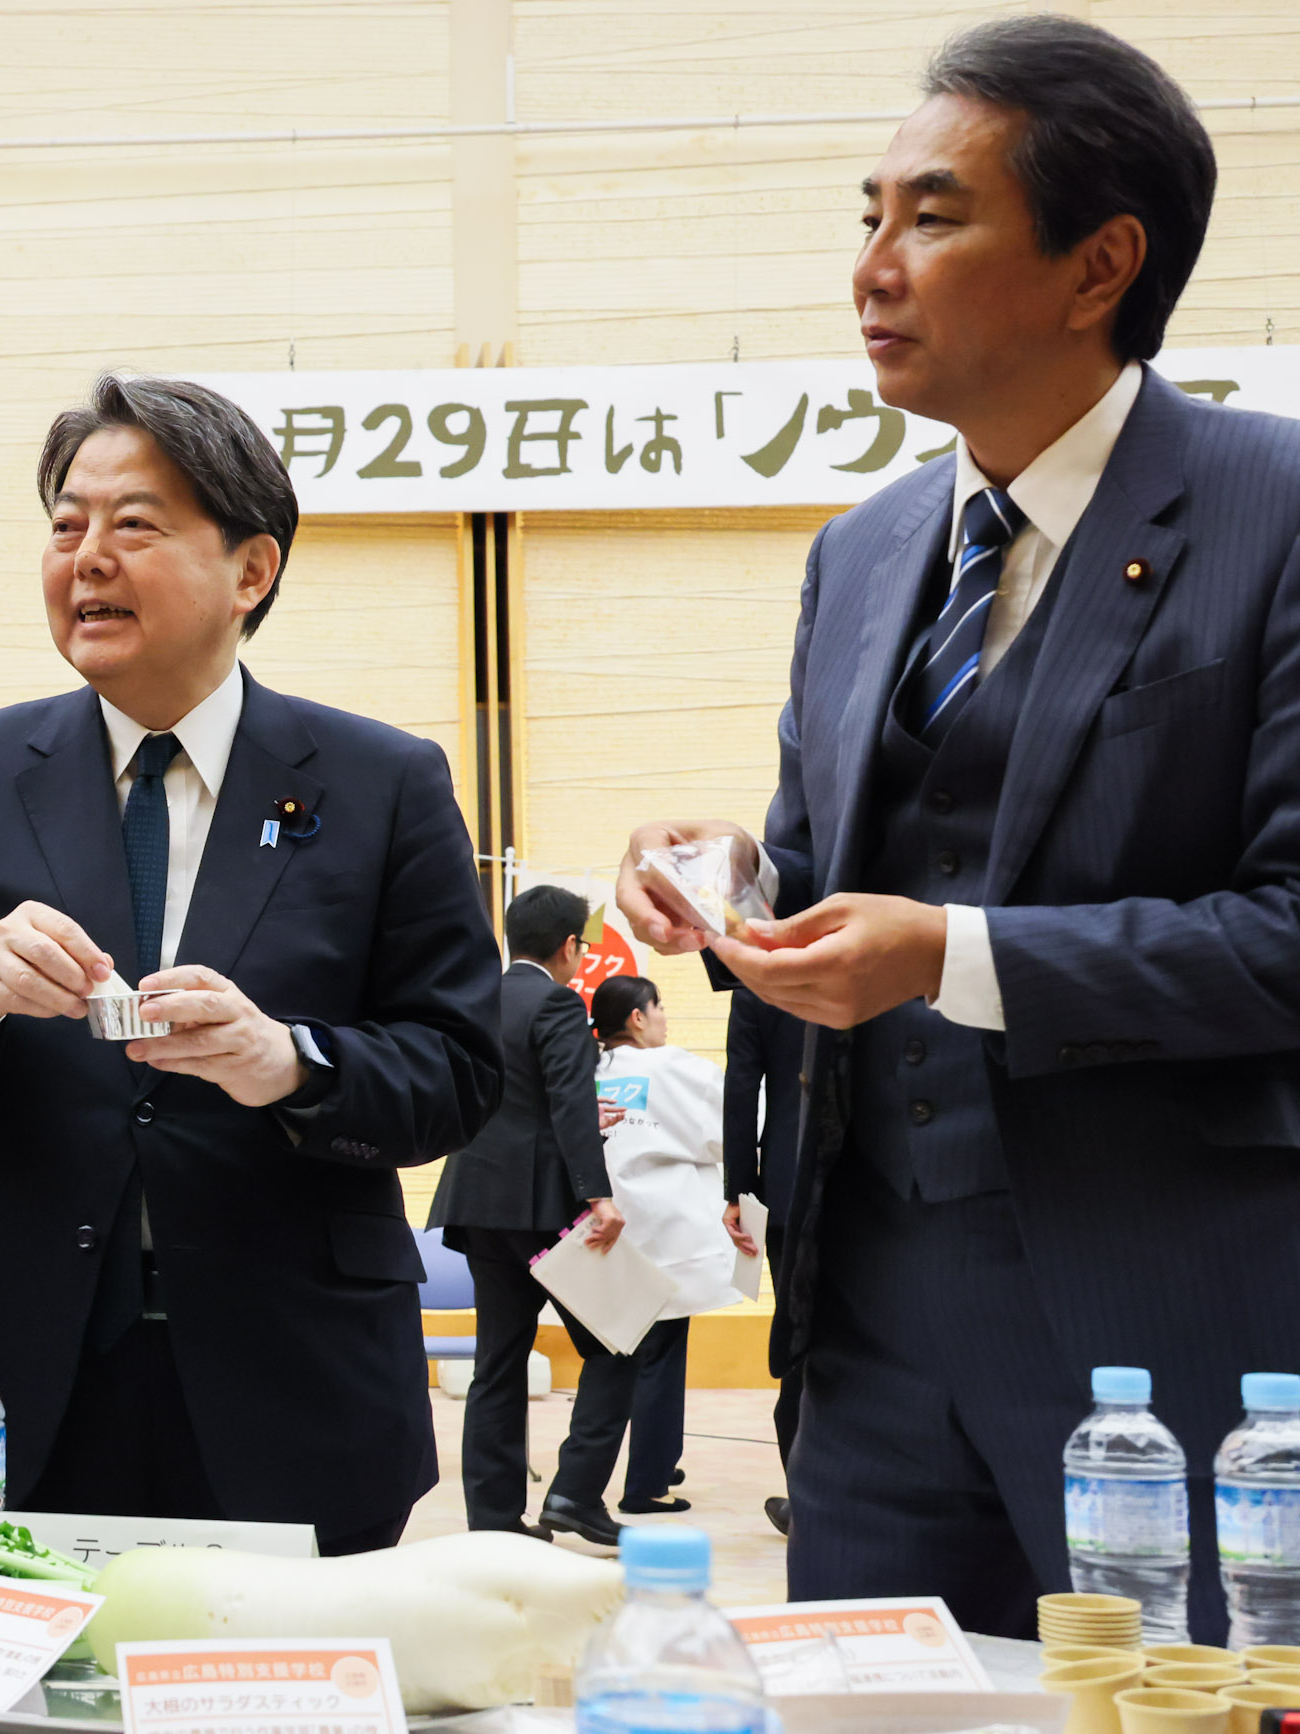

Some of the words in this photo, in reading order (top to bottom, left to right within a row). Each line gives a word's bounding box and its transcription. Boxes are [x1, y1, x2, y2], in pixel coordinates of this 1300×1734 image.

[272, 388, 957, 479] 月29日は「ノウ
